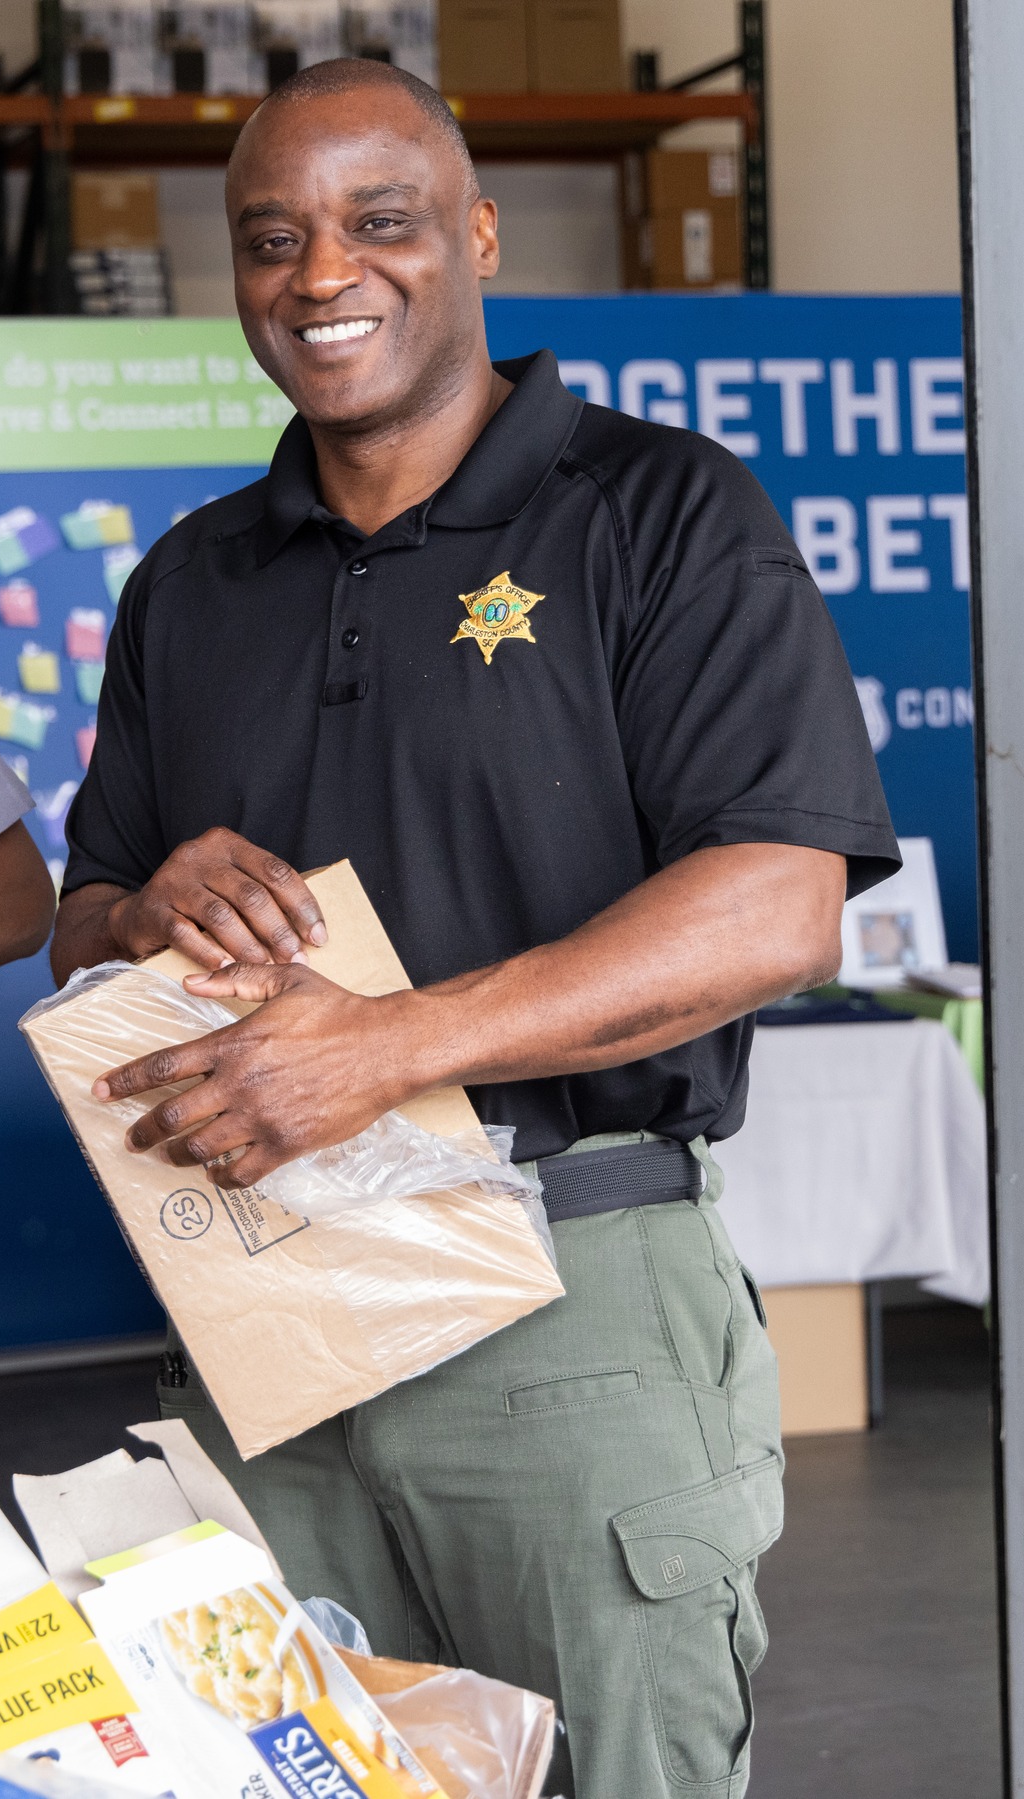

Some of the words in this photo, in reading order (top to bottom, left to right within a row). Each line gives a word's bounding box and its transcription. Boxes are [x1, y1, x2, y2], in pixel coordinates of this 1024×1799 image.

[3, 352, 46, 387] do
[51, 358, 114, 393] you
[119, 354, 200, 385] want
[205, 354, 240, 384] to
[50, 399, 73, 432] &
[78, 397, 212, 432] Connect
[217, 396, 250, 428] in
[505, 585, 532, 607] OFFICE
[499, 619, 528, 637] COUNTY
[482, 638, 494, 647] SC
[226, 1189, 254, 1231] CORRUGAT
[247, 1203, 266, 1229] TESTS
[247, 1230, 263, 1249] THIS
[28, 1612, 61, 1639] 22
[41, 1665, 105, 1705] PACK
[332, 1737, 369, 1779] BUTTER
